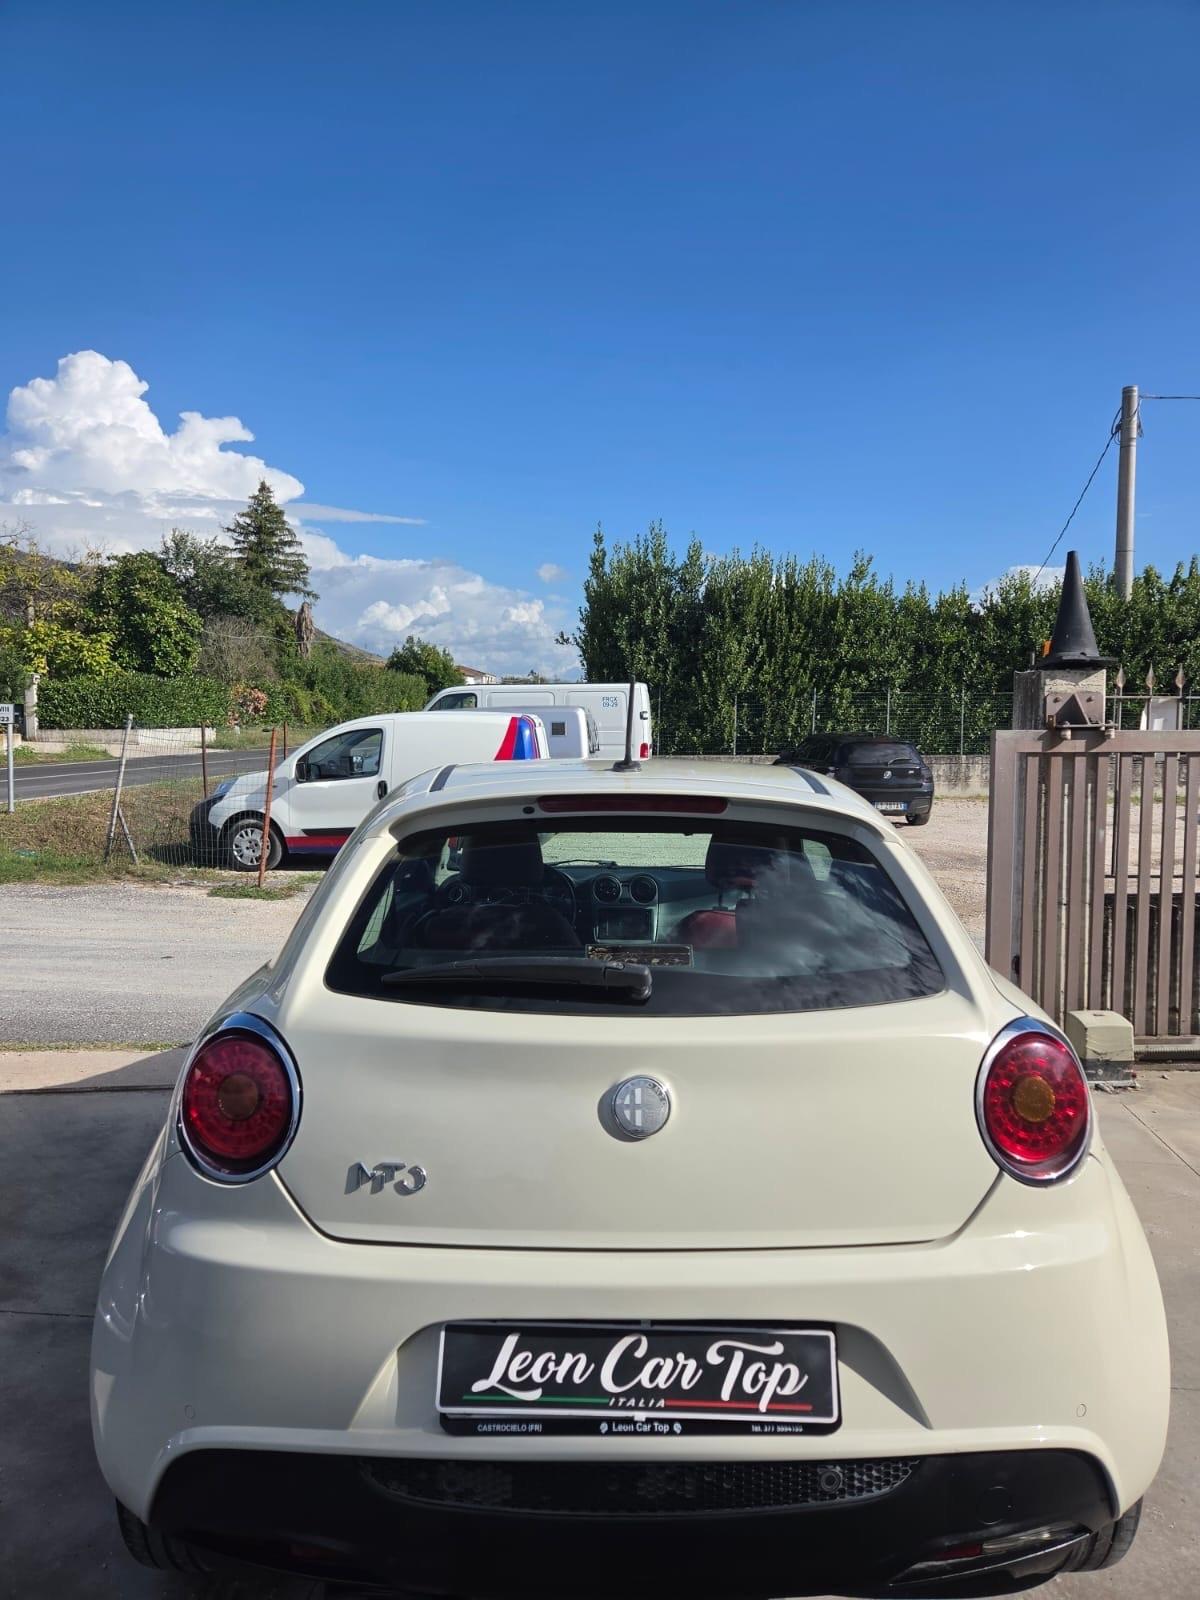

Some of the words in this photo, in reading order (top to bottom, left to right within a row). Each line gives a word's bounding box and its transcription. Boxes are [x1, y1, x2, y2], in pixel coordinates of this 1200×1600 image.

[471, 1332, 595, 1401] Leon
[600, 1333, 702, 1394] Car
[705, 1340, 809, 1413] Top
[609, 1397, 667, 1409] ITALIA
[612, 1422, 634, 1432] Leon
[636, 1422, 651, 1432] Car
[653, 1422, 670, 1434] Top
